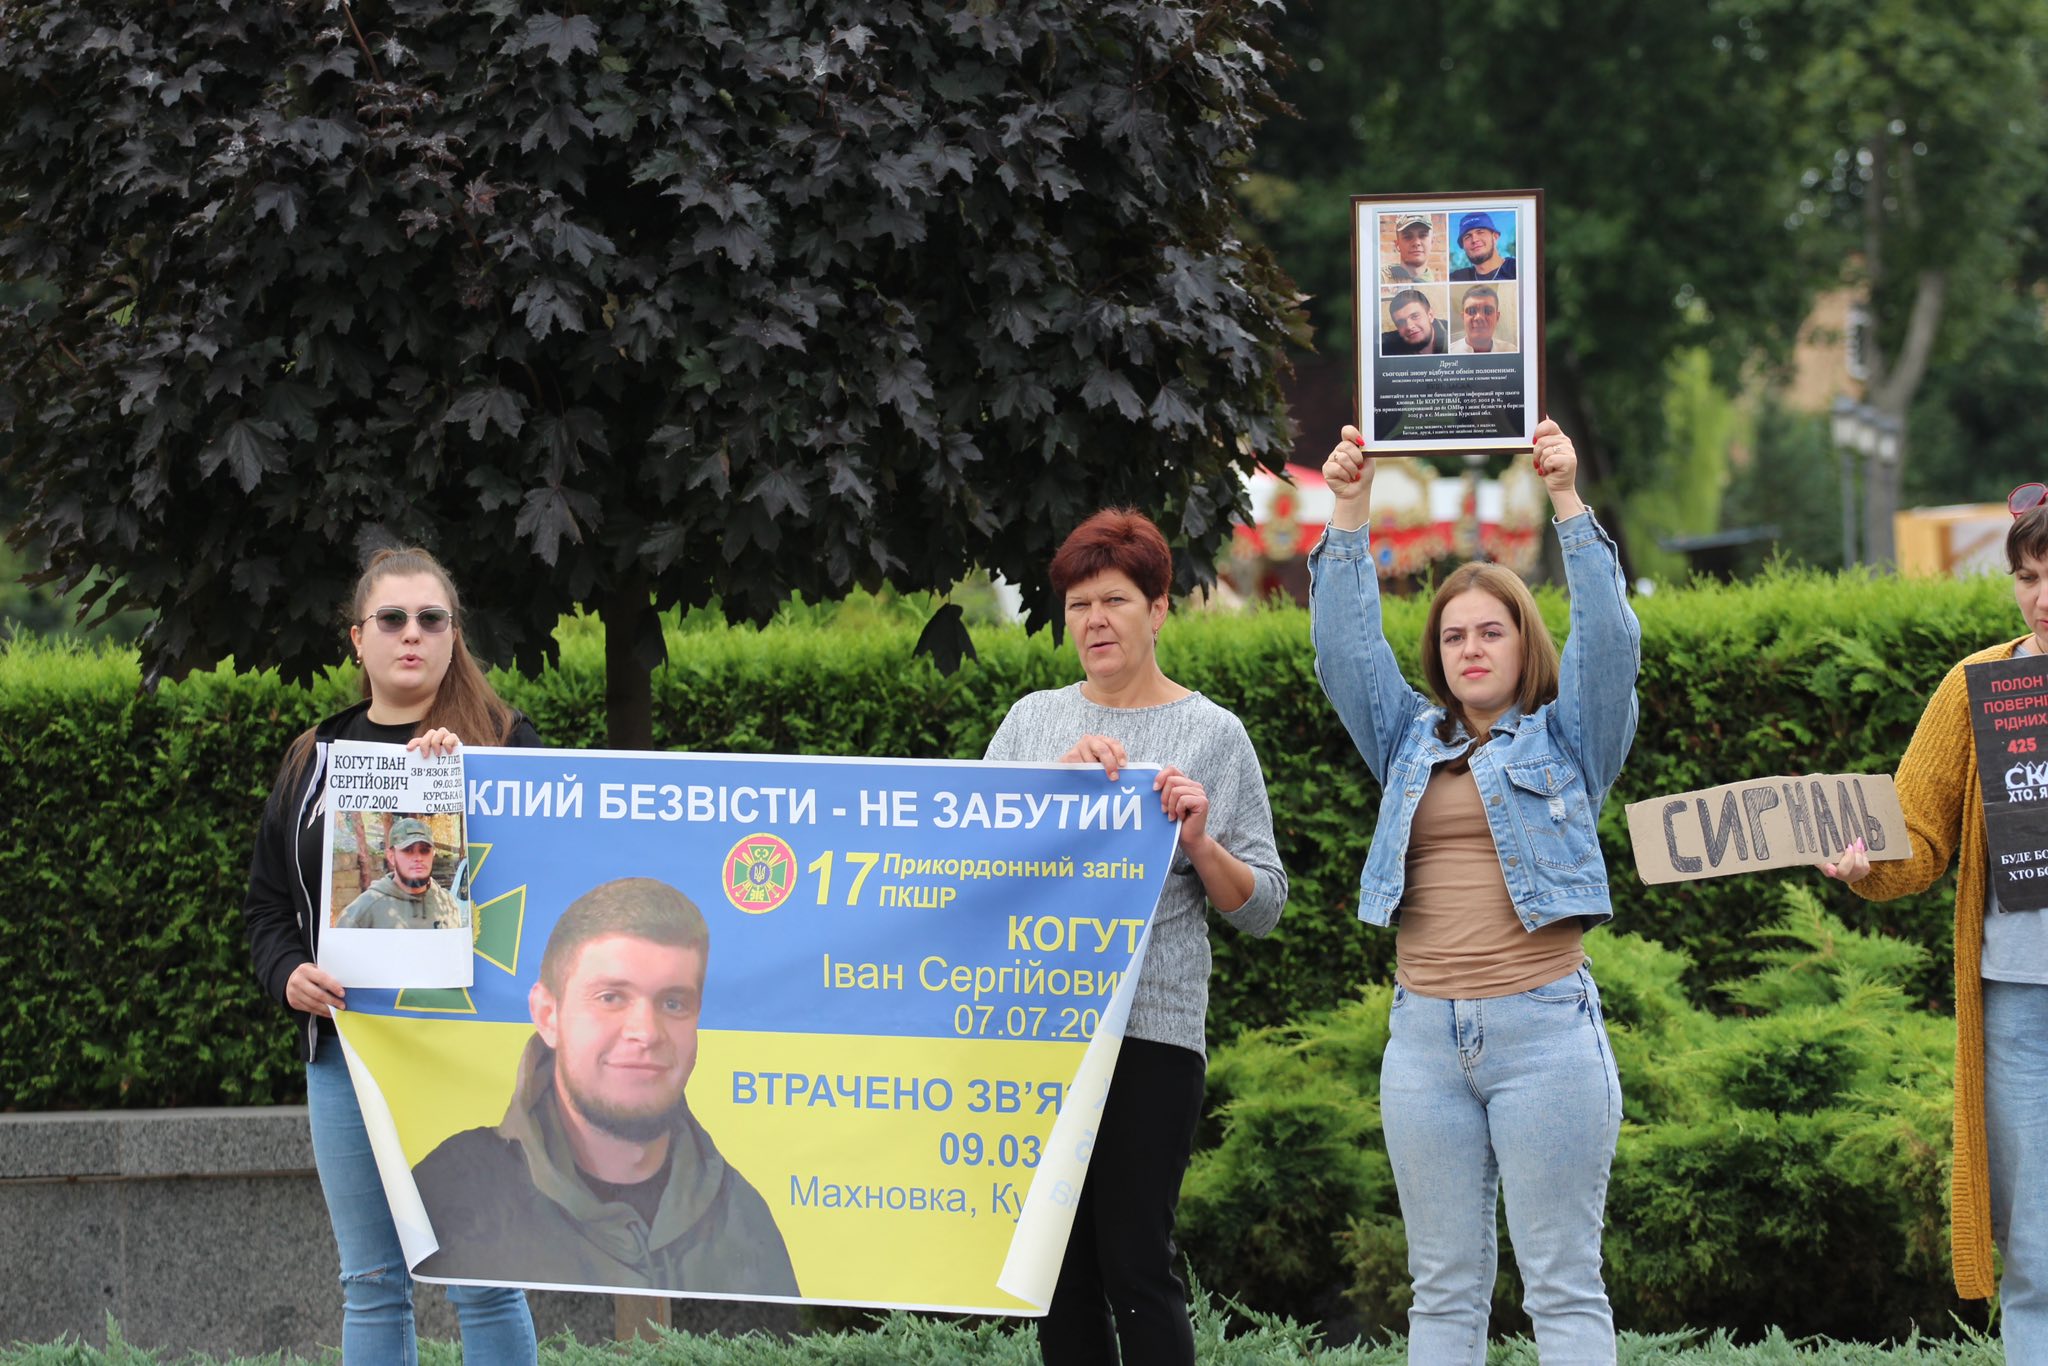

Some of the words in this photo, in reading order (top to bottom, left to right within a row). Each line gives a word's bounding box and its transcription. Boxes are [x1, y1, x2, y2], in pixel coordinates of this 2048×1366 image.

[1991, 675, 2043, 693] ПОЛОН
[1983, 695, 2048, 715] ПОВЕРНІ
[1994, 712, 2048, 731] РІДНИХ
[2007, 737, 2037, 753] 425
[334, 755, 374, 770] КОГУТ
[376, 756, 407, 771] ІВАН
[437, 756, 447, 765] 17
[329, 772, 409, 790] СЕРГІЙОВИЧ
[410, 767, 450, 777] ЗВ'ЯЗОК
[338, 794, 399, 810] 07.07.2002
[423, 791, 459, 801] КУРСЬКА
[468, 773, 583, 818] КЛИЙ
[600, 782, 816, 825] БЕЗВІСТИ
[859, 790, 919, 827] НЕ
[933, 786, 1142, 831] ЗАБУТИЙ
[2007, 788, 2037, 803] ХТО,
[426, 803, 433, 813] С
[1662, 779, 1886, 873] СИГНАЛЬ
[2001, 851, 2032, 865] БУДЕ
[2034, 849, 2048, 860] БО
[807, 849, 880, 906] 17
[883, 852, 1074, 881] Прикордонний
[1082, 857, 1145, 880] загін
[2008, 868, 2034, 881] ХТО
[878, 885, 957, 909] ПКШР
[1007, 915, 1145, 954] КОГУТ
[823, 953, 903, 990] Іван
[918, 955, 1125, 1001] Сергійови
[954, 1004, 1100, 1039] 07.07.20
[732, 1070, 953, 1112] ВТРАЧЕНО
[967, 1079, 1073, 1115] ЗВ’Я
[939, 1132, 1041, 1169] 09.03
[790, 1174, 977, 1218] Махновка,
[991, 1182, 1025, 1223] Ку
